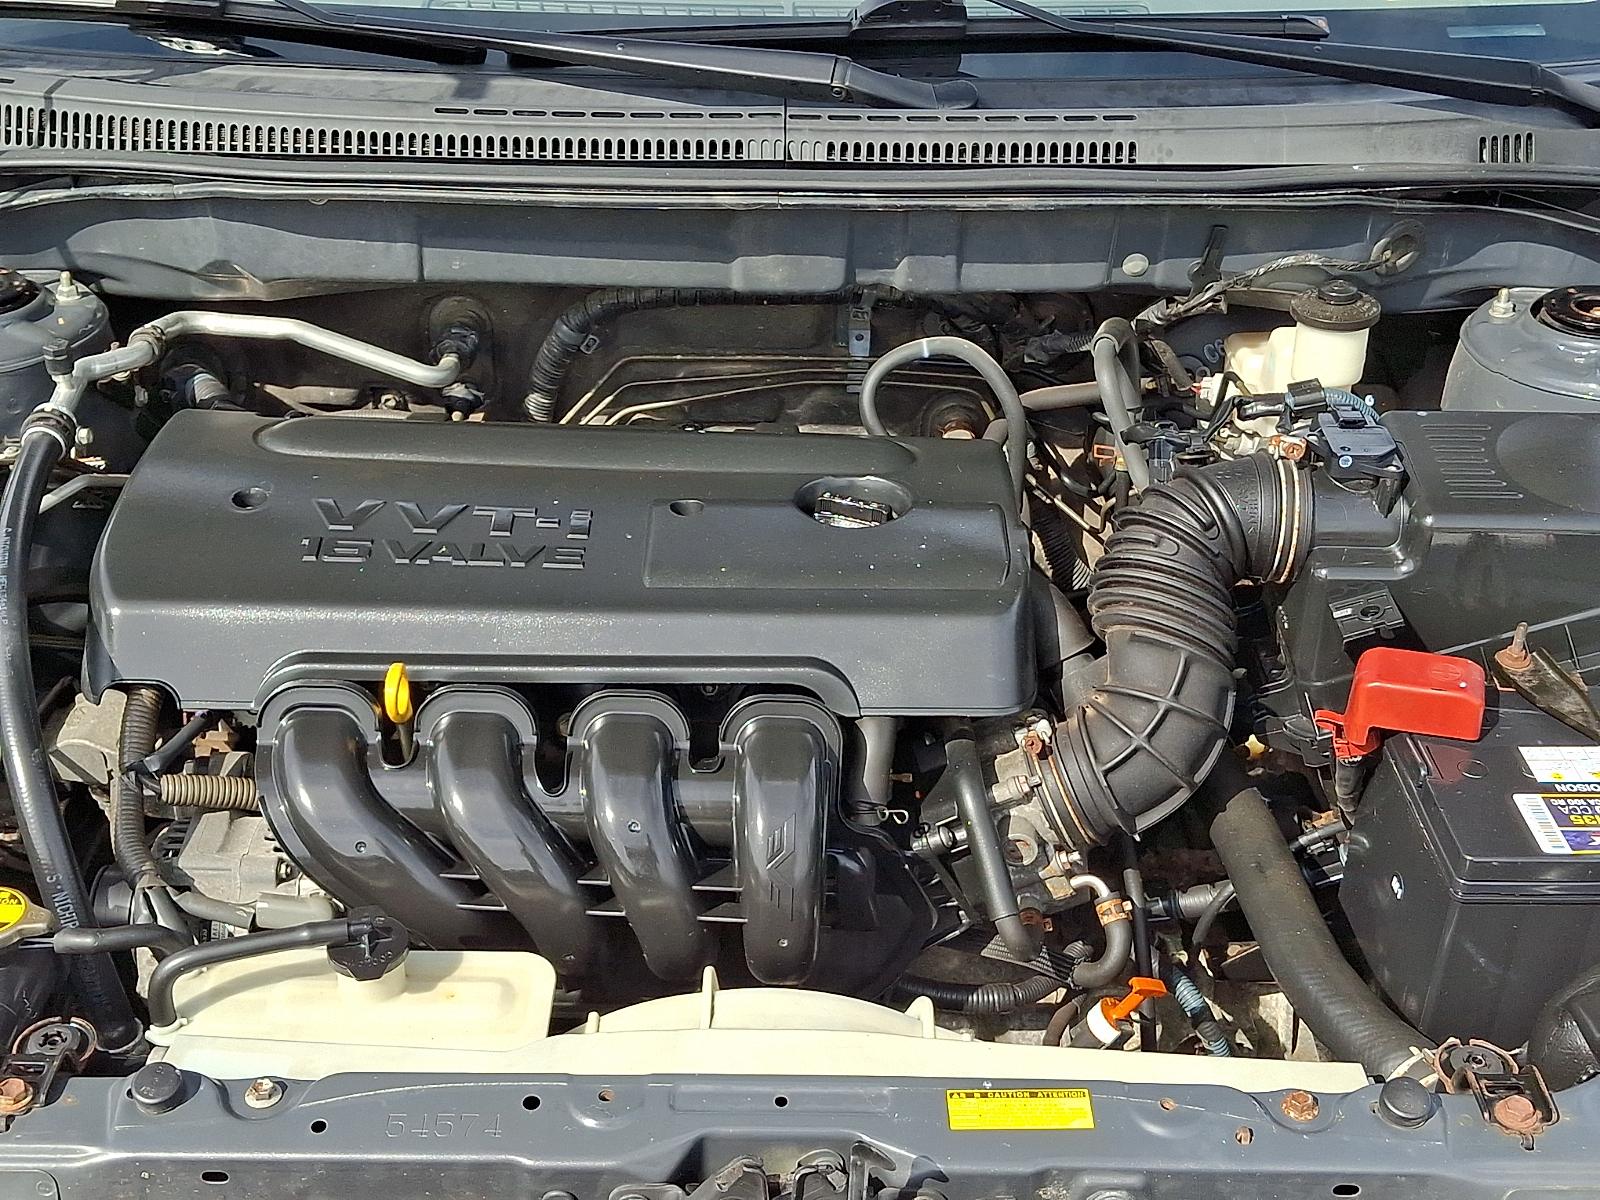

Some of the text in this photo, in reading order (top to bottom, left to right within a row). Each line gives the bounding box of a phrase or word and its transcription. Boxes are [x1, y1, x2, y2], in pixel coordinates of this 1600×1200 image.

[301, 536, 587, 570] 16 VALVE
[1557, 805, 1592, 815] CCA
[385, 1113, 502, 1138] 54574
